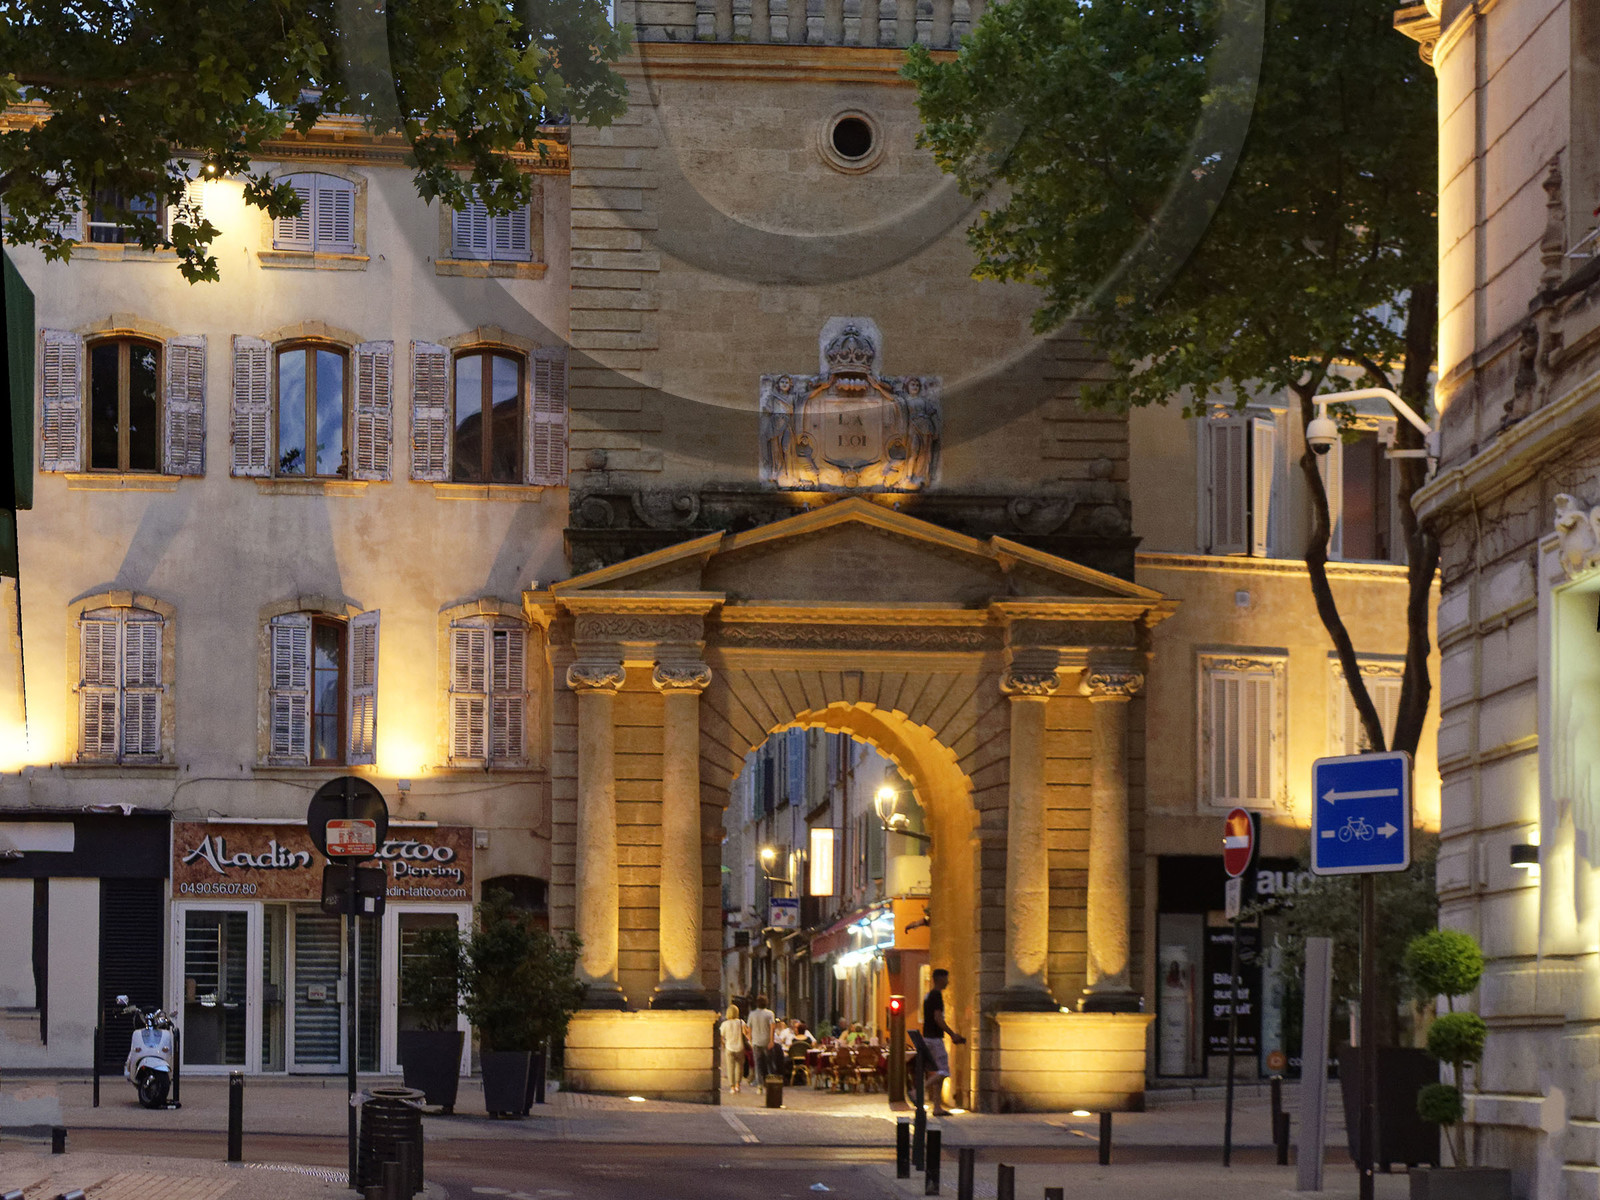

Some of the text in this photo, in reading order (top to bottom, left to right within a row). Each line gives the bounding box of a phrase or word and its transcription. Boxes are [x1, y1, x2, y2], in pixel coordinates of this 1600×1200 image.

[838, 413, 864, 426] LA
[838, 435, 867, 447] LOI
[182, 834, 310, 875] Aladin
[393, 861, 461, 883] Piercing
[180, 882, 257, 895] 04.90.56.07.80
